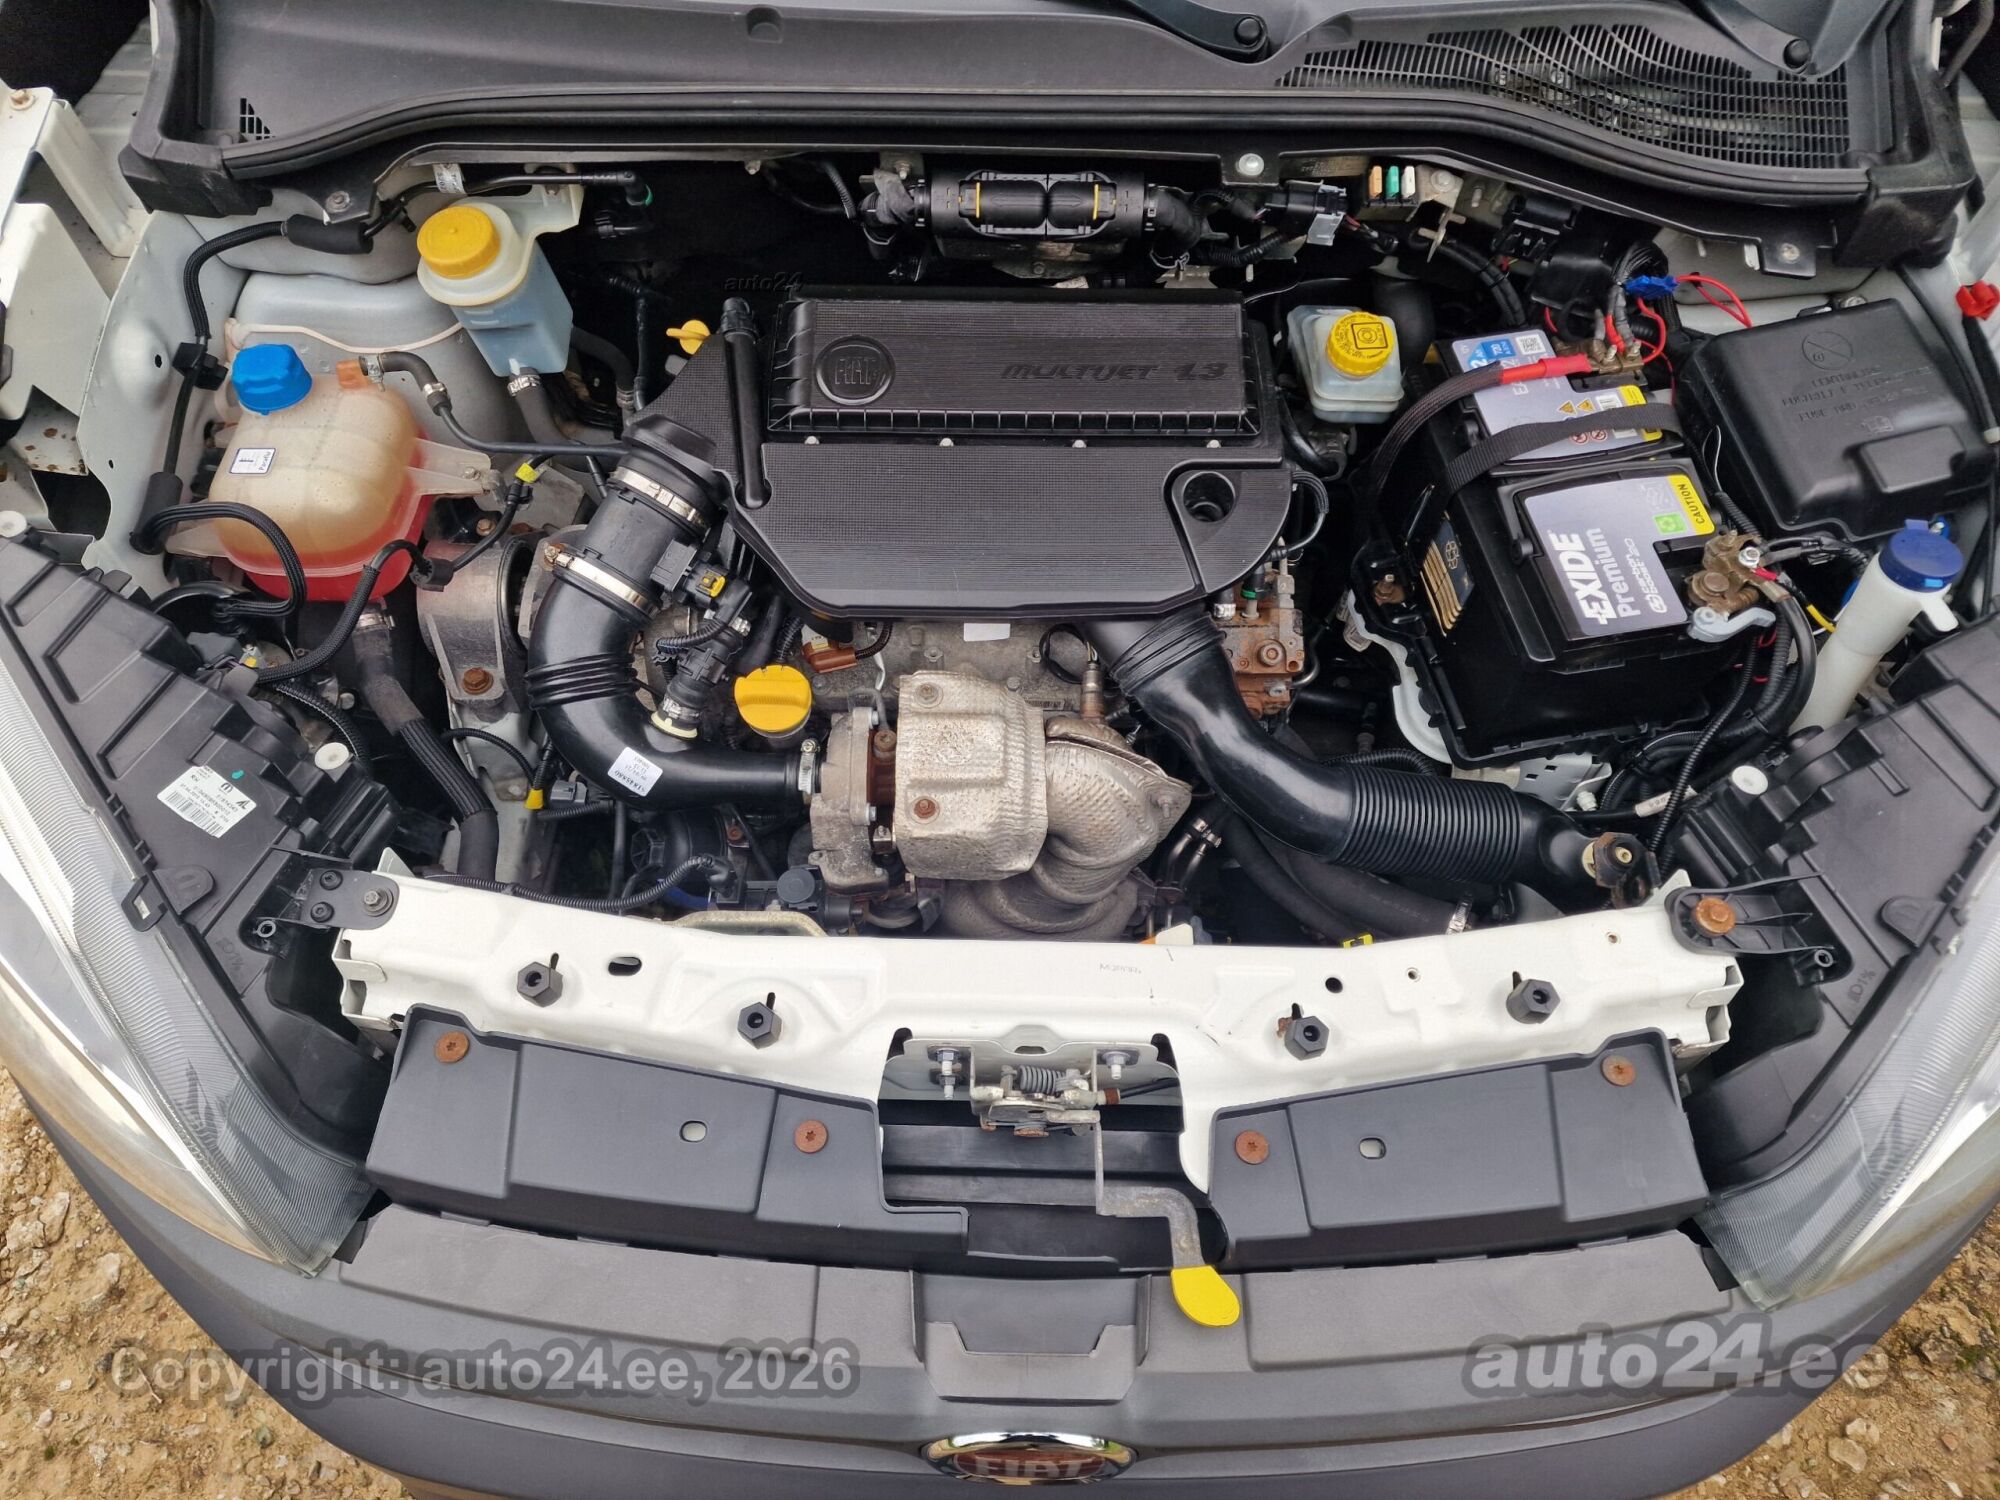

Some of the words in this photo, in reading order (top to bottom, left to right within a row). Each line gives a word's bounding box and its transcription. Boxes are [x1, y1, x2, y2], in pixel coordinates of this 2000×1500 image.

[1677, 483, 1705, 525] CAUTION
[1549, 532, 1617, 624] EXIDE
[1586, 528, 1641, 618] Premium
[975, 1455, 1093, 1478] FIAT
